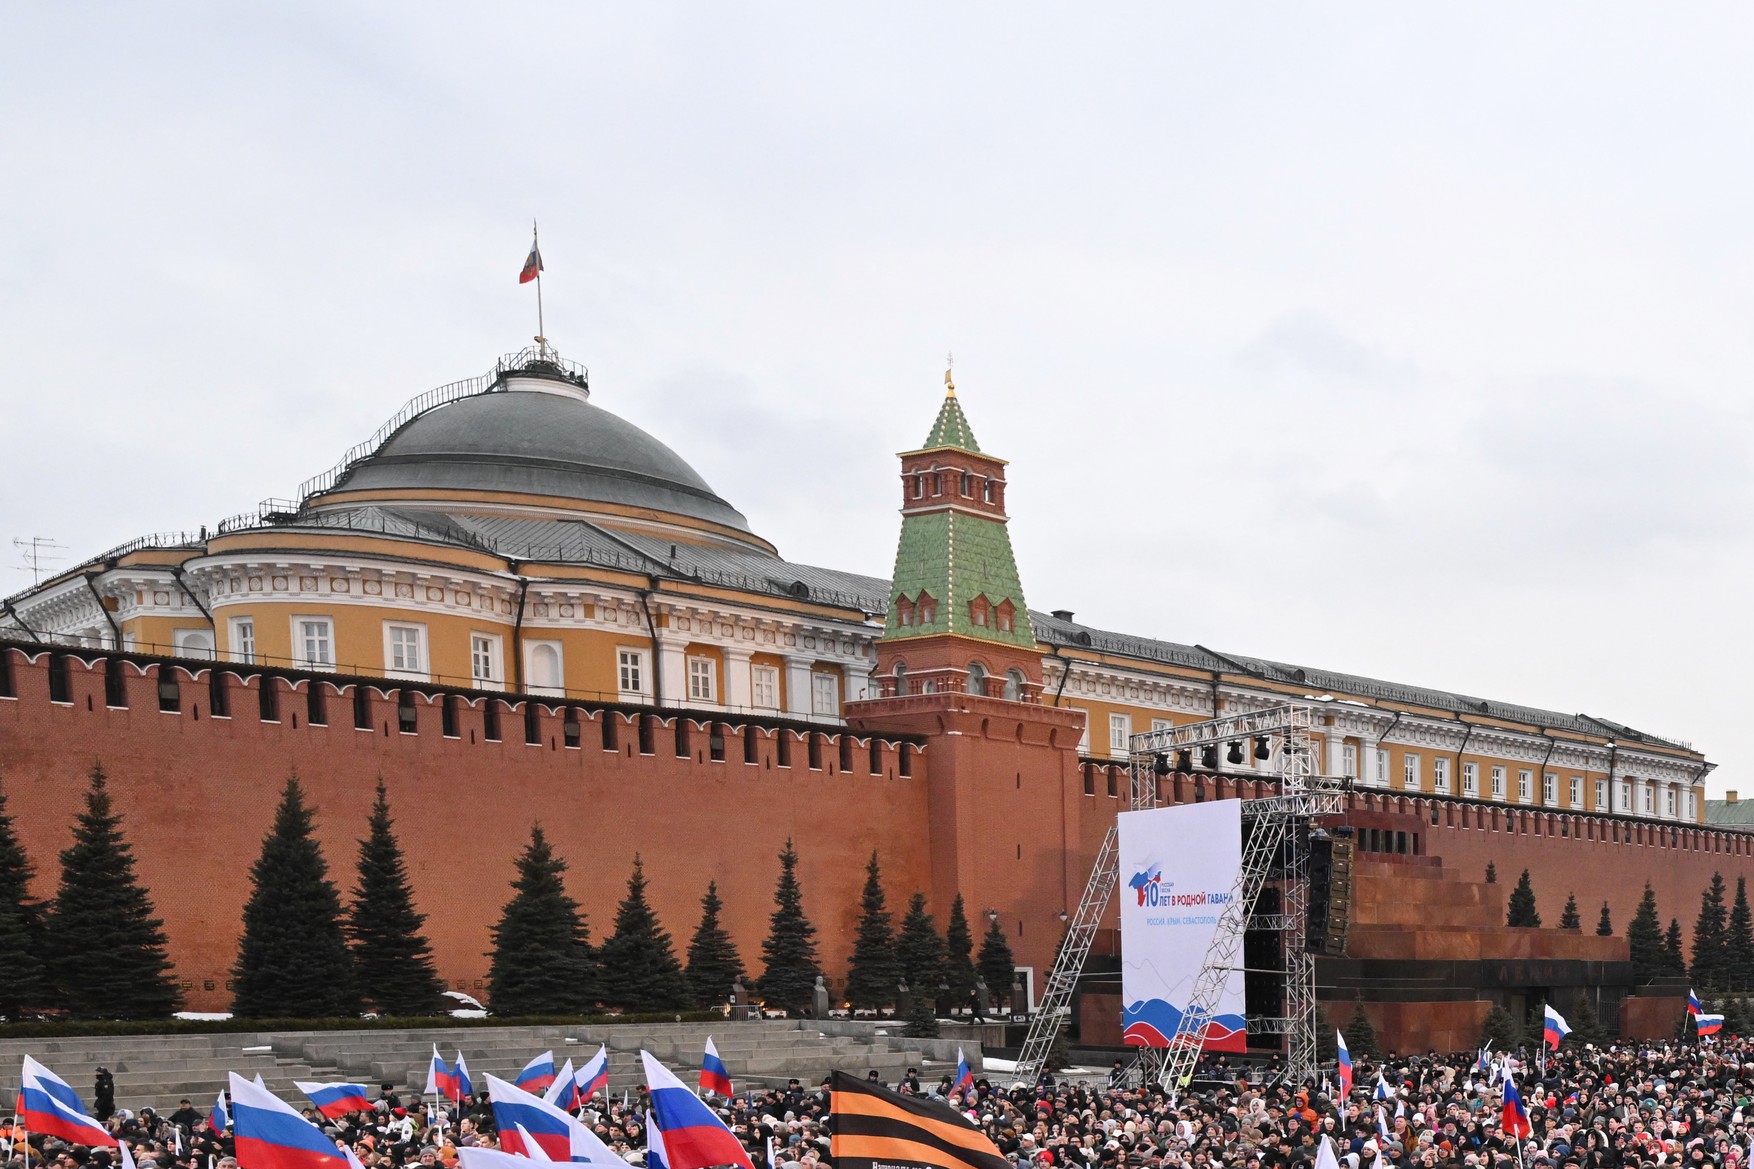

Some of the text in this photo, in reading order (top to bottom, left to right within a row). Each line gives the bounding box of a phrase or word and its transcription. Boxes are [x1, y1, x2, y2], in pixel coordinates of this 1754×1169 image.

[1144, 881, 1159, 907] 10
[1159, 895, 1171, 907] ЛЕТ
[1171, 895, 1176, 906] В
[1177, 891, 1206, 907] РОДНОЙ
